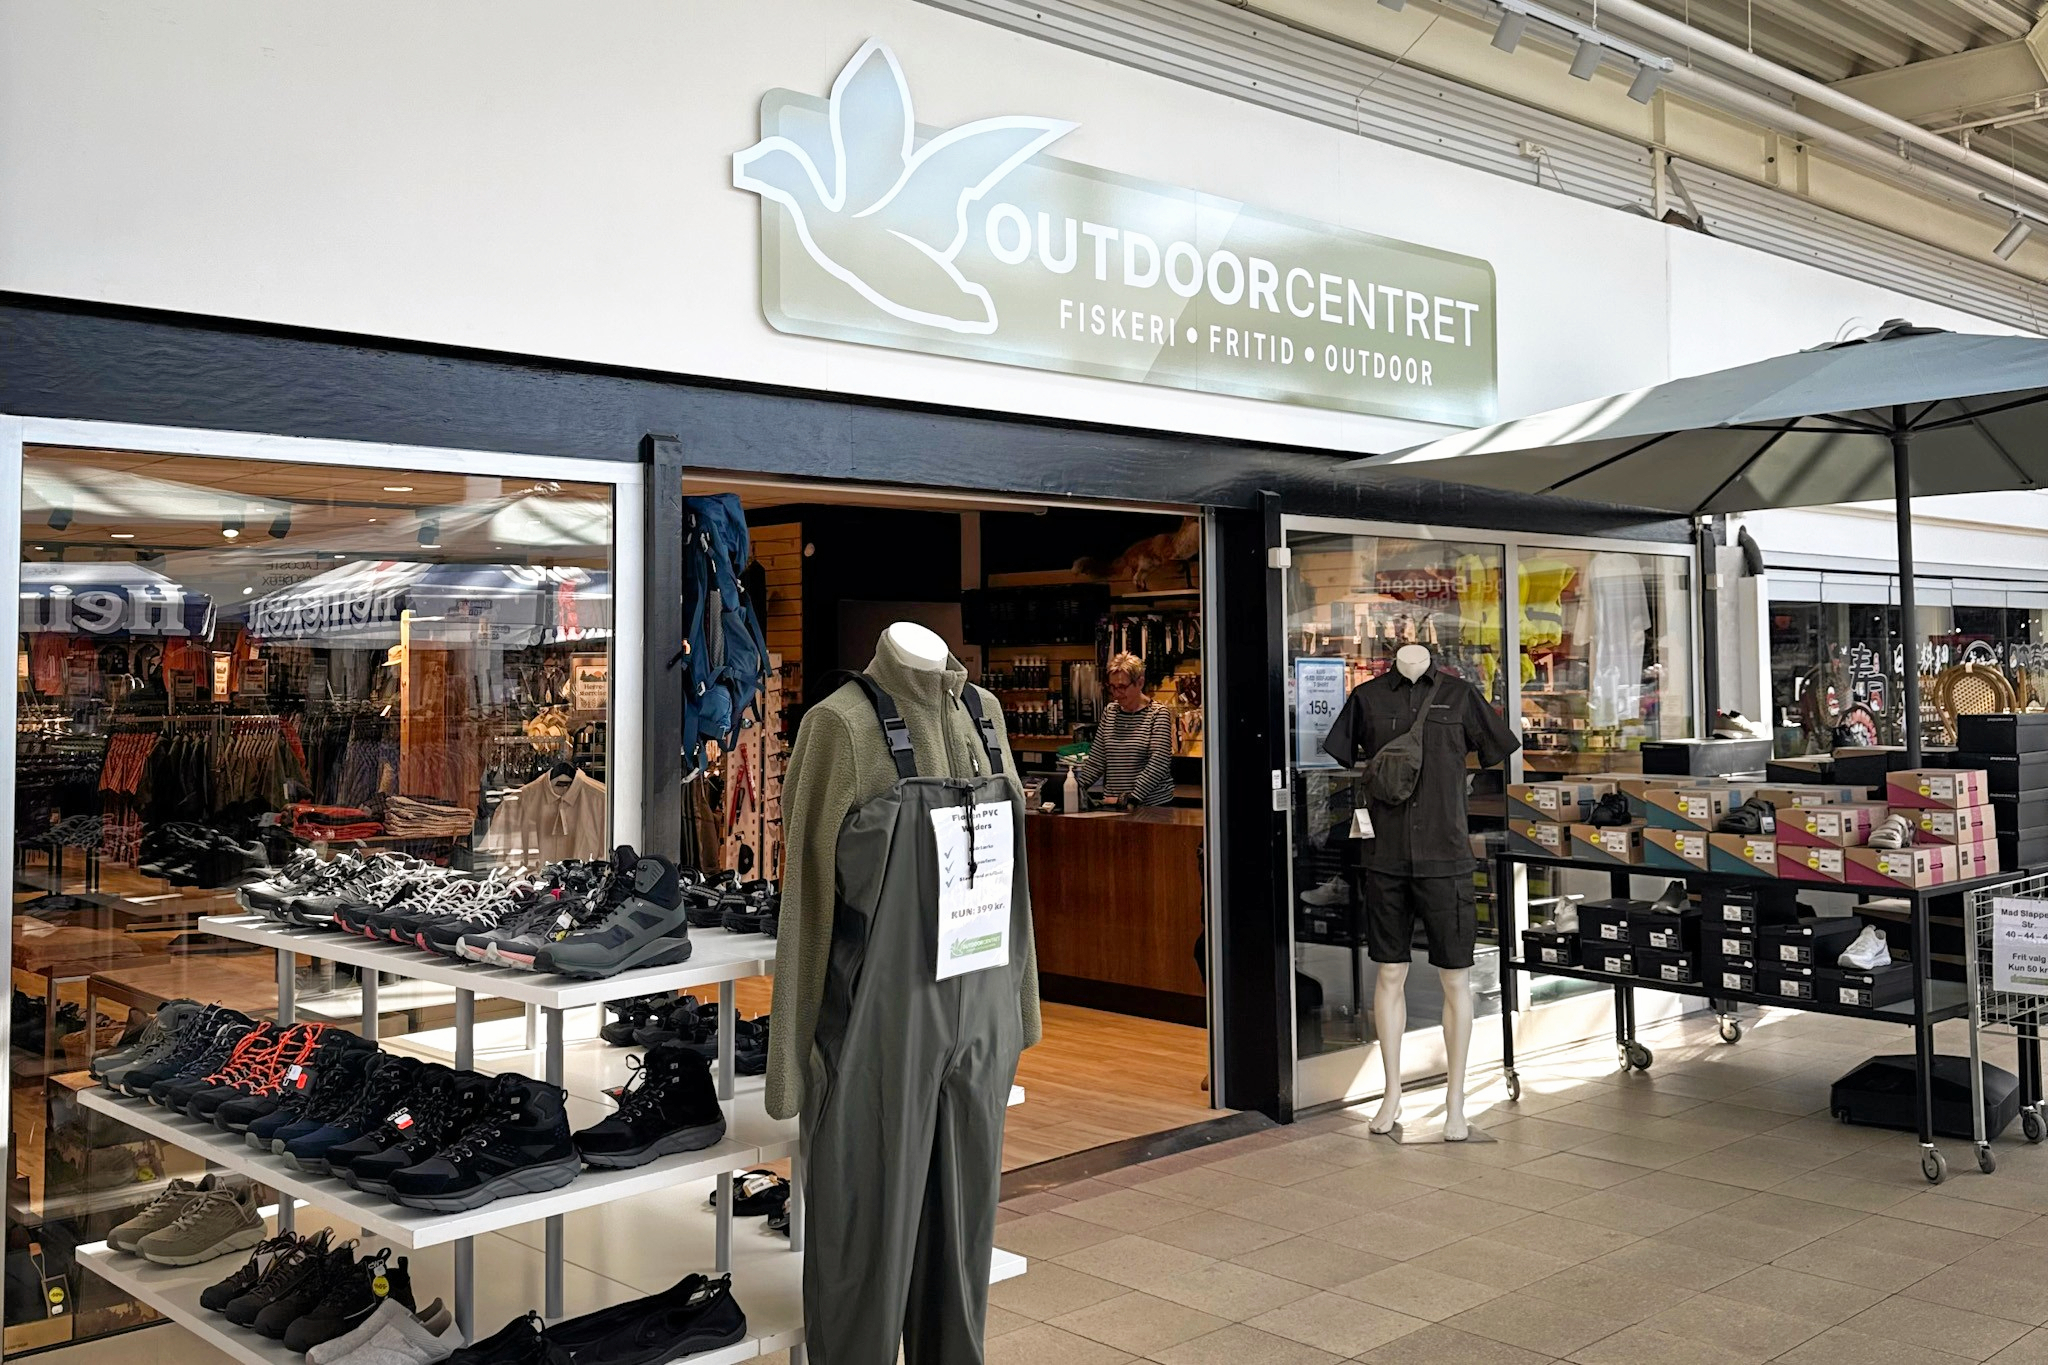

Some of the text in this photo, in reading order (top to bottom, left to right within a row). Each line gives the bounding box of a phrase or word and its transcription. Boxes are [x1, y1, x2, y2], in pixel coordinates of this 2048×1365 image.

[986, 202, 1480, 348] OUTDOORCENTRET
[1058, 298, 1434, 388] FISKERI FRITID OUTDOOR
[982, 808, 998, 818] PVC
[961, 823, 992, 832] Wders
[951, 907, 975, 919] KUN:
[977, 903, 993, 914] 399
[2001, 908, 2018, 917] Mad
[2021, 920, 2037, 929] Str.
[2005, 930, 2016, 938] 40
[2012, 952, 2047, 964] Frit valg
[2008, 963, 2025, 972] Kun
[2027, 965, 2038, 973] 50
